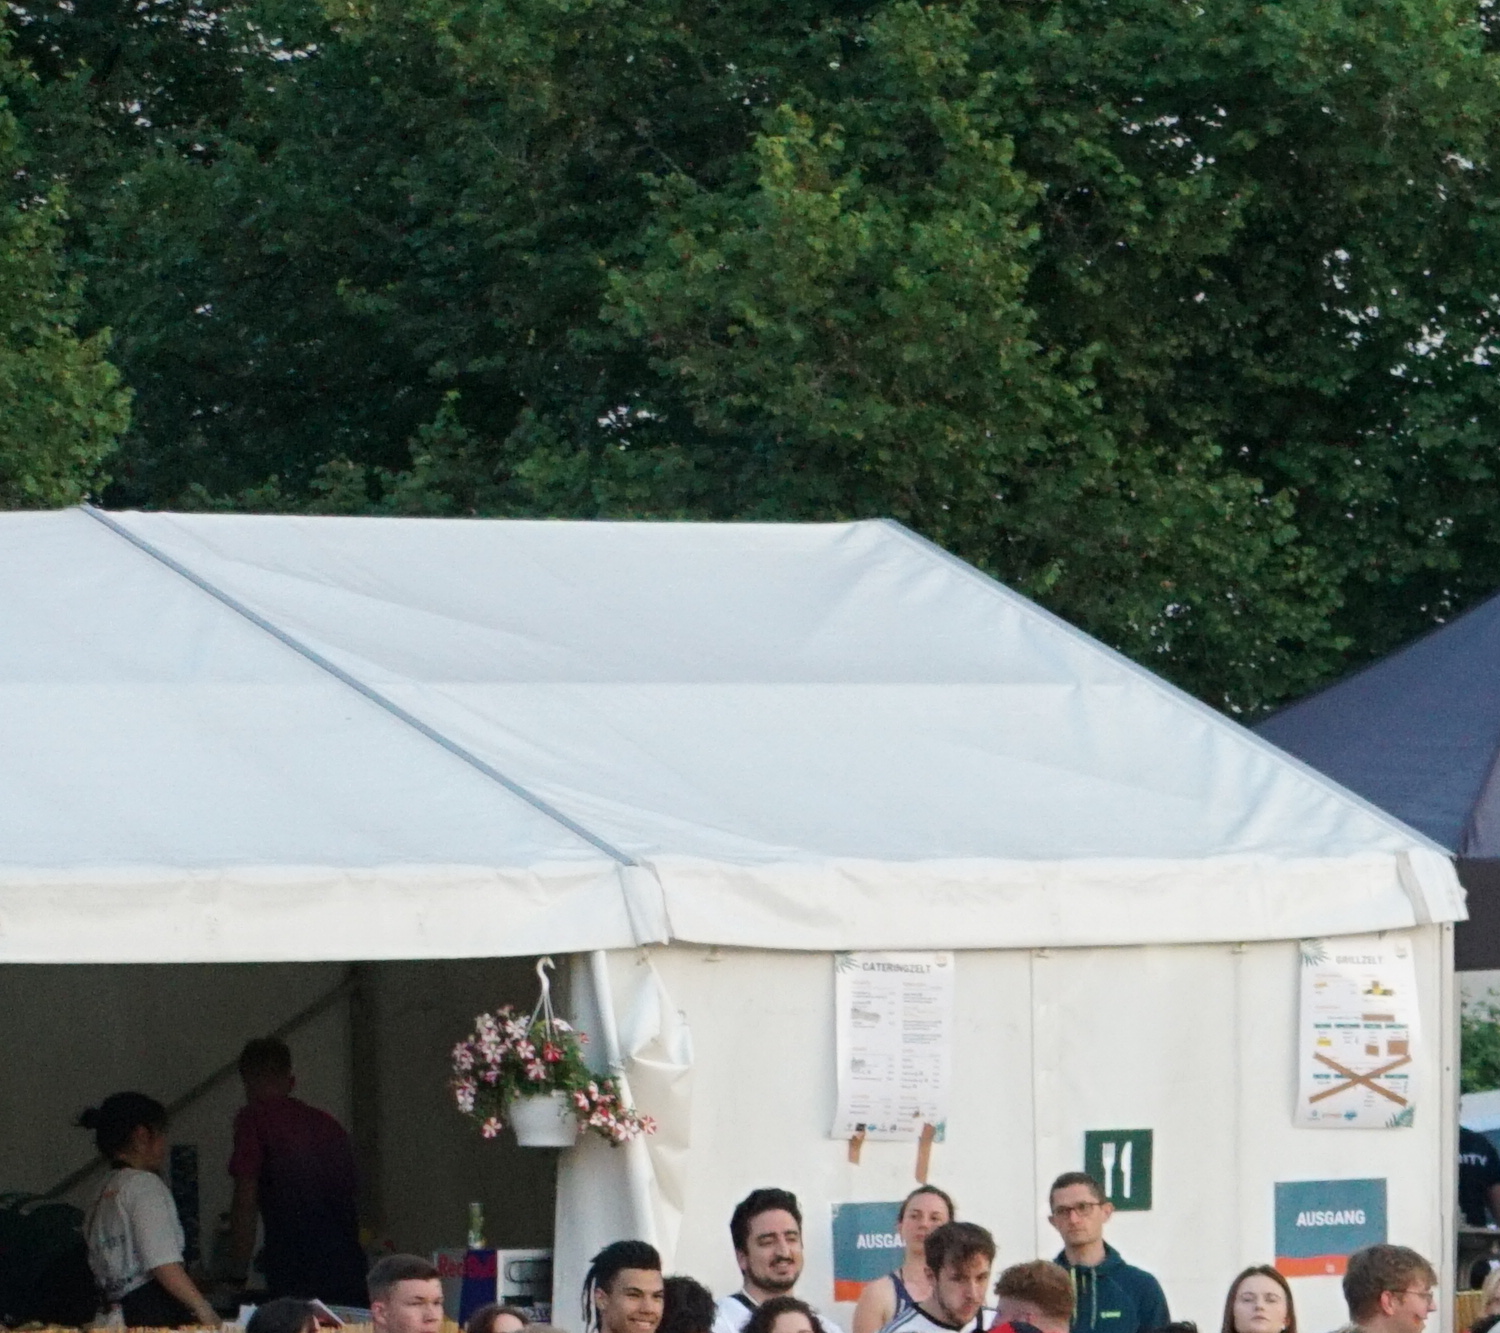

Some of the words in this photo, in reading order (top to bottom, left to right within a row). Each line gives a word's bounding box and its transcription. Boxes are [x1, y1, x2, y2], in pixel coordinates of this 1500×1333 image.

[862, 962, 931, 973] CATERINGZELT
[1296, 1209, 1366, 1227] AUSGANG
[857, 1233, 906, 1249] AUSGA
